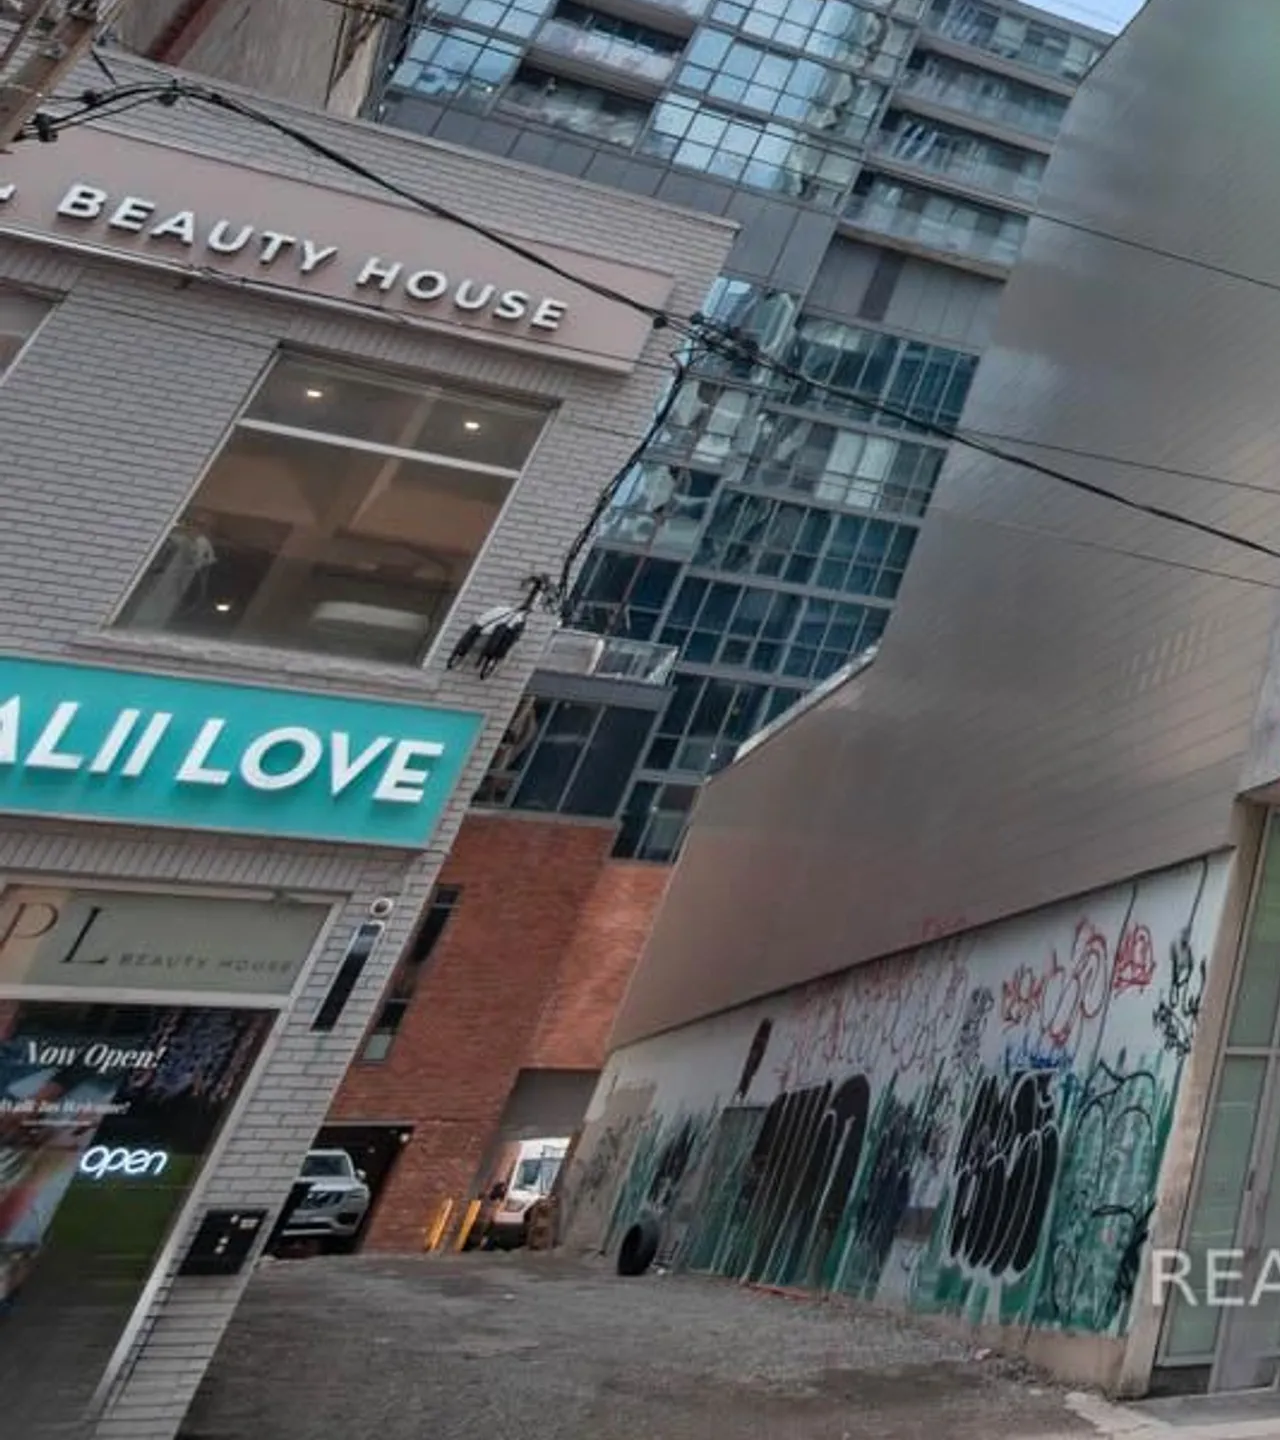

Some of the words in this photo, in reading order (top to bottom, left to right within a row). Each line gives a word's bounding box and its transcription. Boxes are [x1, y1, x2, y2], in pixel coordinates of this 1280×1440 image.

[57, 184, 337, 272] BEAUTY
[356, 257, 568, 331] HOUSE
[176, 718, 445, 803] LOVE
[83, 1043, 168, 1074] Open!
[80, 1144, 169, 1179] open
